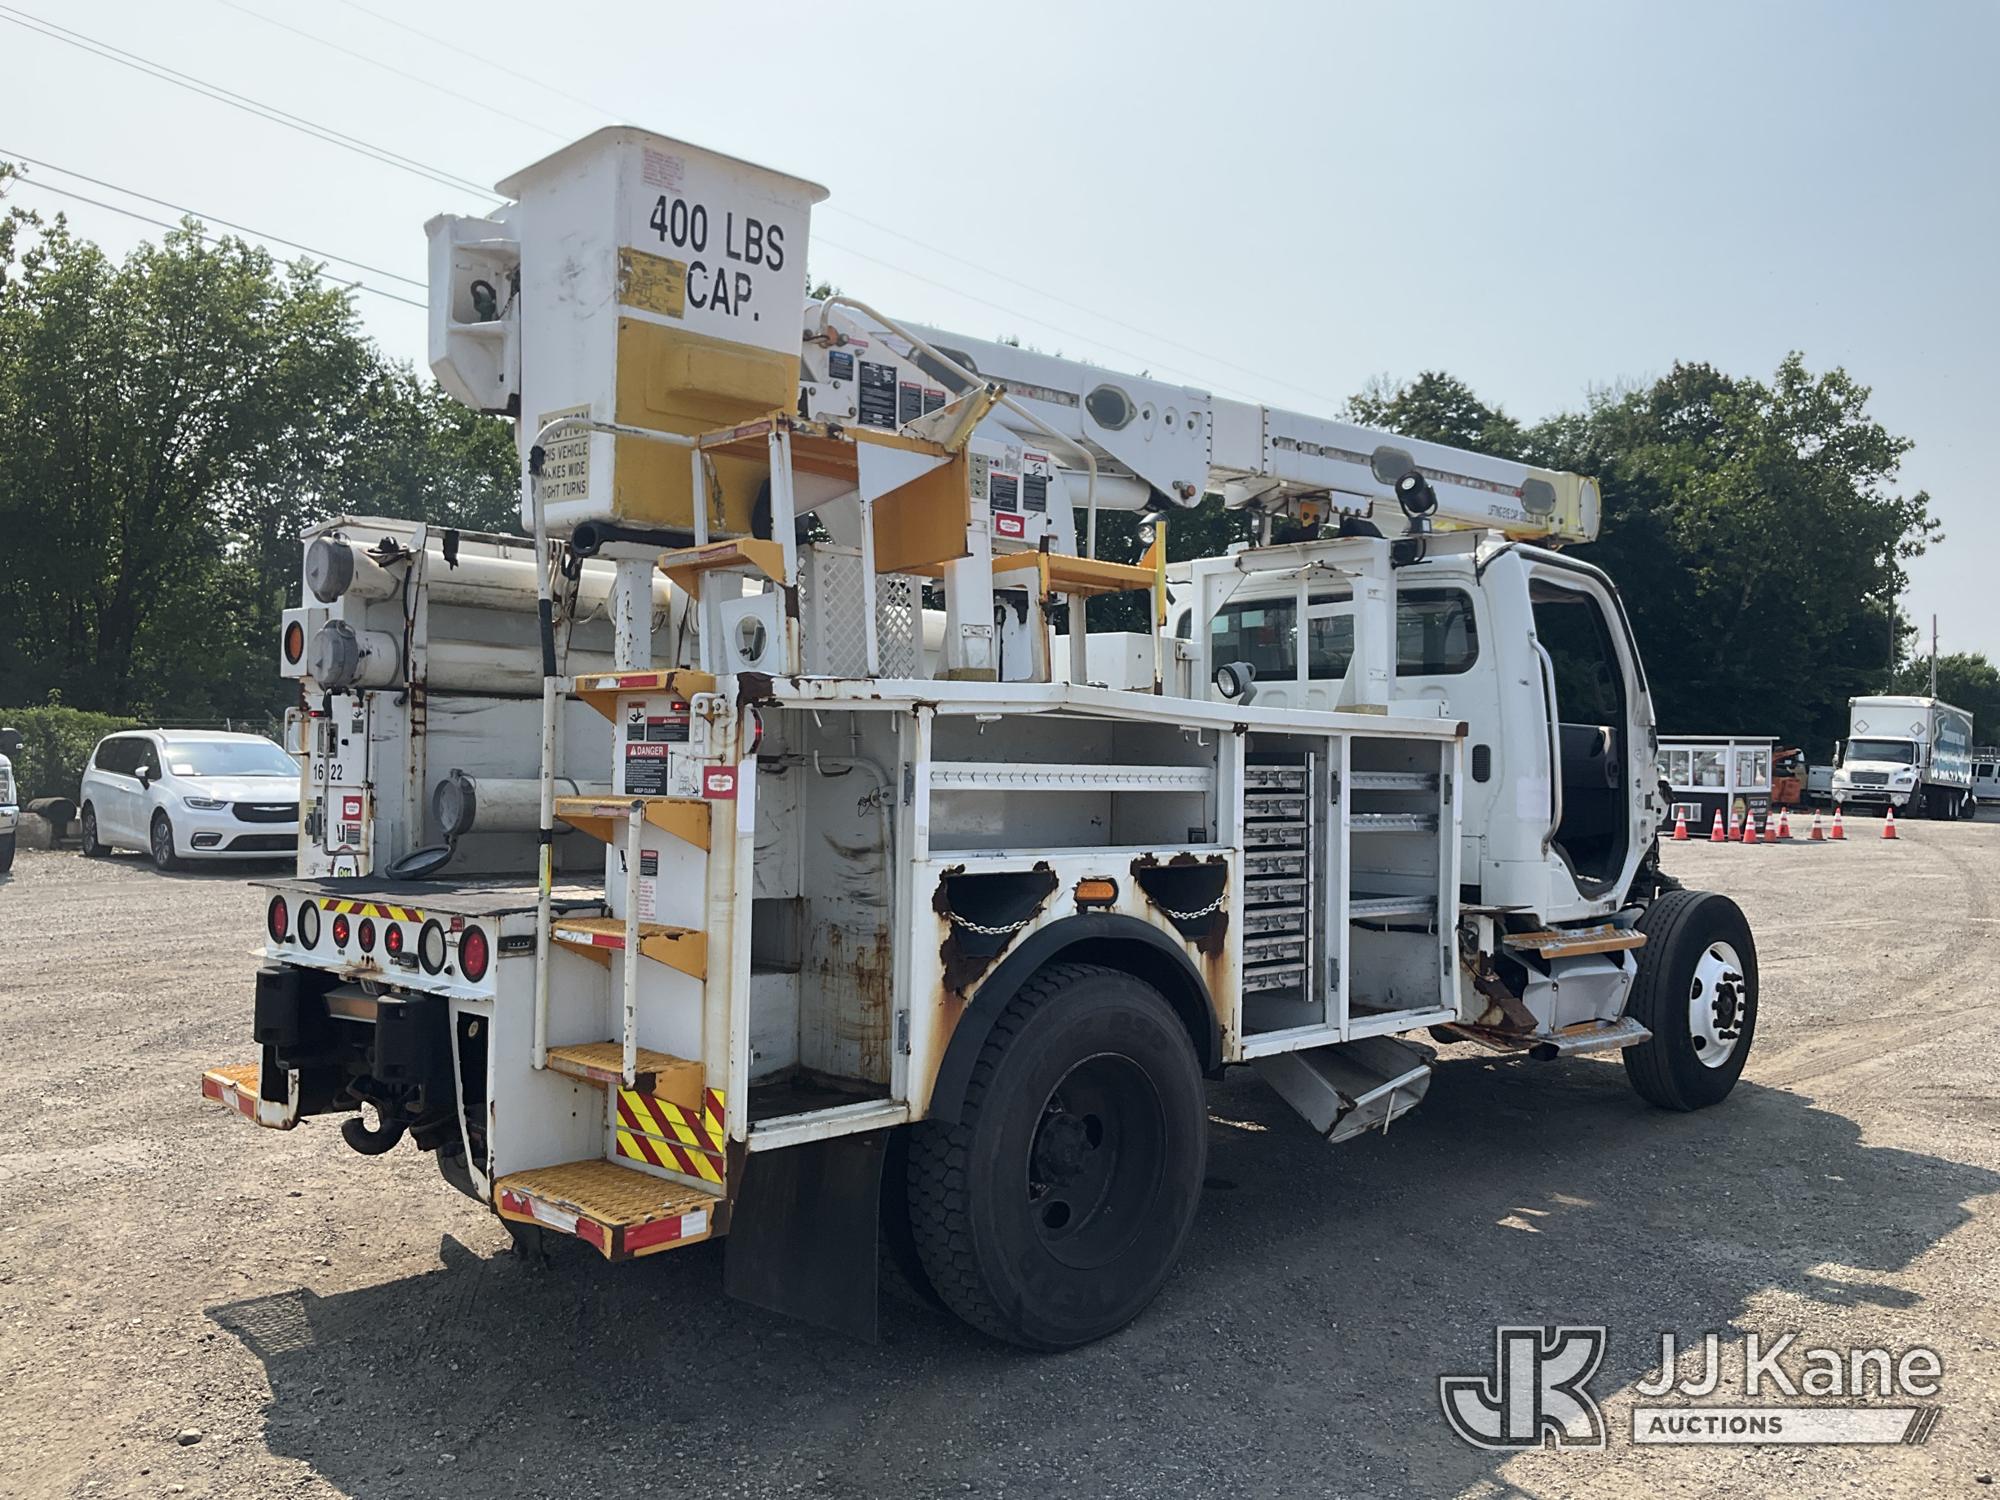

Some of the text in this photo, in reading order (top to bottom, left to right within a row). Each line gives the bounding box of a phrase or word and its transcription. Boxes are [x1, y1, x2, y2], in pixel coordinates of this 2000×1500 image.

[650, 195, 784, 271] 400 LBS
[687, 260, 759, 321] CAP.
[558, 442, 587, 460] VEHICLE
[568, 461, 585, 477] WIDE
[562, 480, 586, 497] TURNS
[637, 746, 663, 756] DANGER
